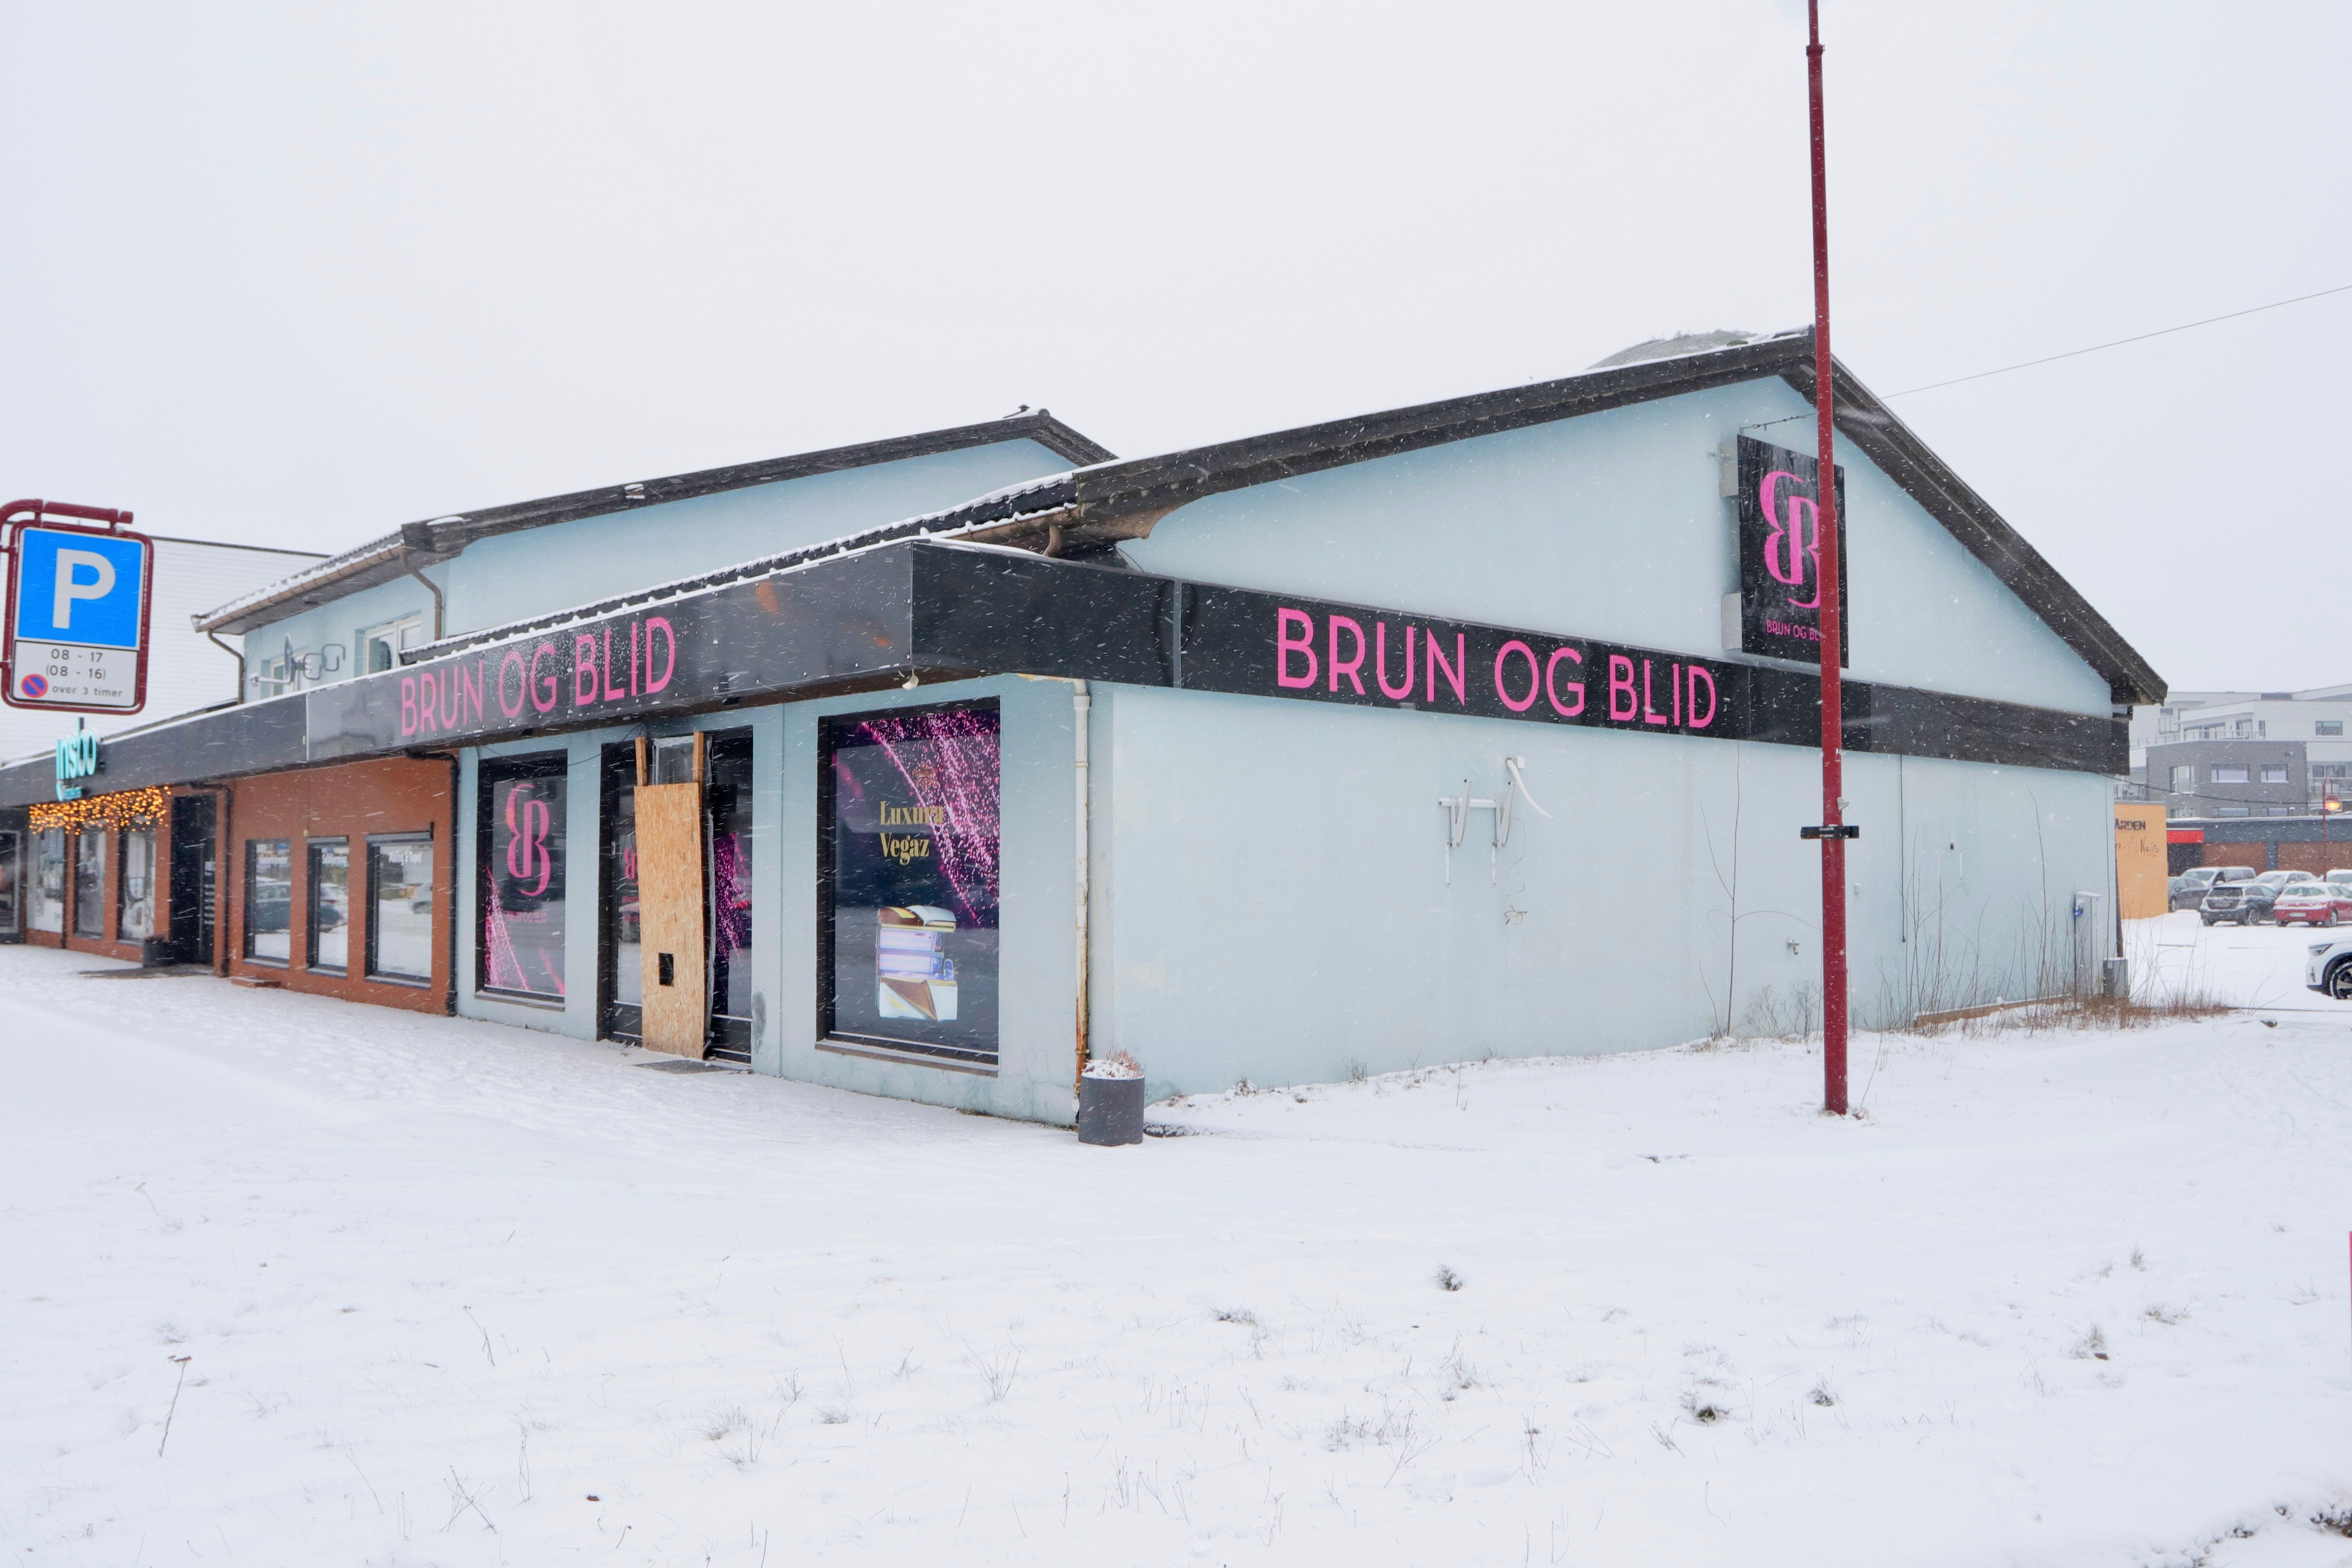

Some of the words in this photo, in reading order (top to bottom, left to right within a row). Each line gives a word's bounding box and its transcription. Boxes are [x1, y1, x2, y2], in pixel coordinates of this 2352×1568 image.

[52, 548, 116, 630] P
[1766, 619, 1790, 635] BRUN
[1793, 624, 1807, 639] OG
[1809, 627, 1820, 641] BL
[51, 648, 69, 660] 08
[90, 652, 103, 662] 17
[46, 664, 67, 676] (08
[89, 668, 106, 680] 16)
[401, 657, 483, 737] BRUN
[498, 643, 557, 718] OG
[575, 616, 676, 706] BLID
[1277, 607, 1465, 706] BRUN
[1494, 640, 1585, 717] OG
[1609, 654, 1717, 729] BLID
[94, 687, 123, 697] timer
[880, 800, 944, 825] Luxura
[880, 832, 930, 866] Vegaz
